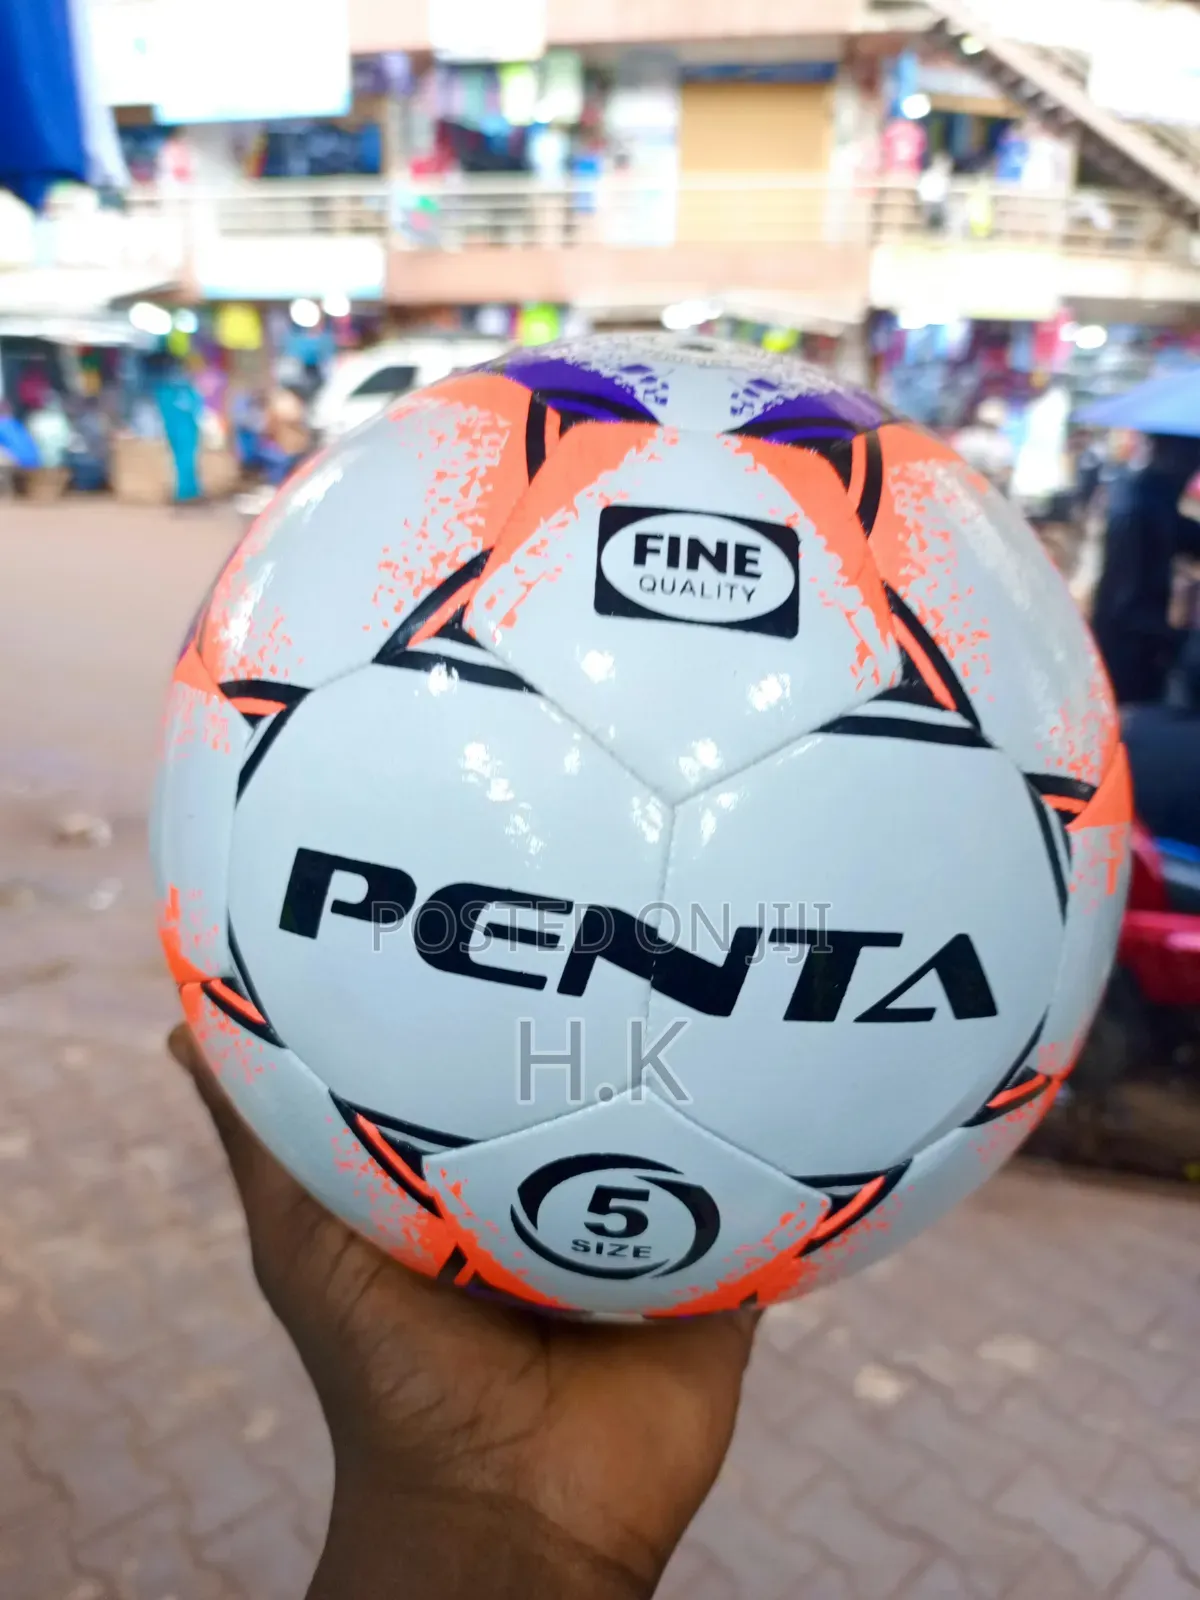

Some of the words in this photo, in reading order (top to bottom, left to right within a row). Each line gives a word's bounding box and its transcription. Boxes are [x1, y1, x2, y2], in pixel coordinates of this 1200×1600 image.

[634, 533, 762, 579] FINE
[638, 574, 757, 603] QUALITY
[278, 847, 999, 1023] PENTA
[583, 1184, 650, 1239] 5
[571, 1238, 653, 1259] SIZE
